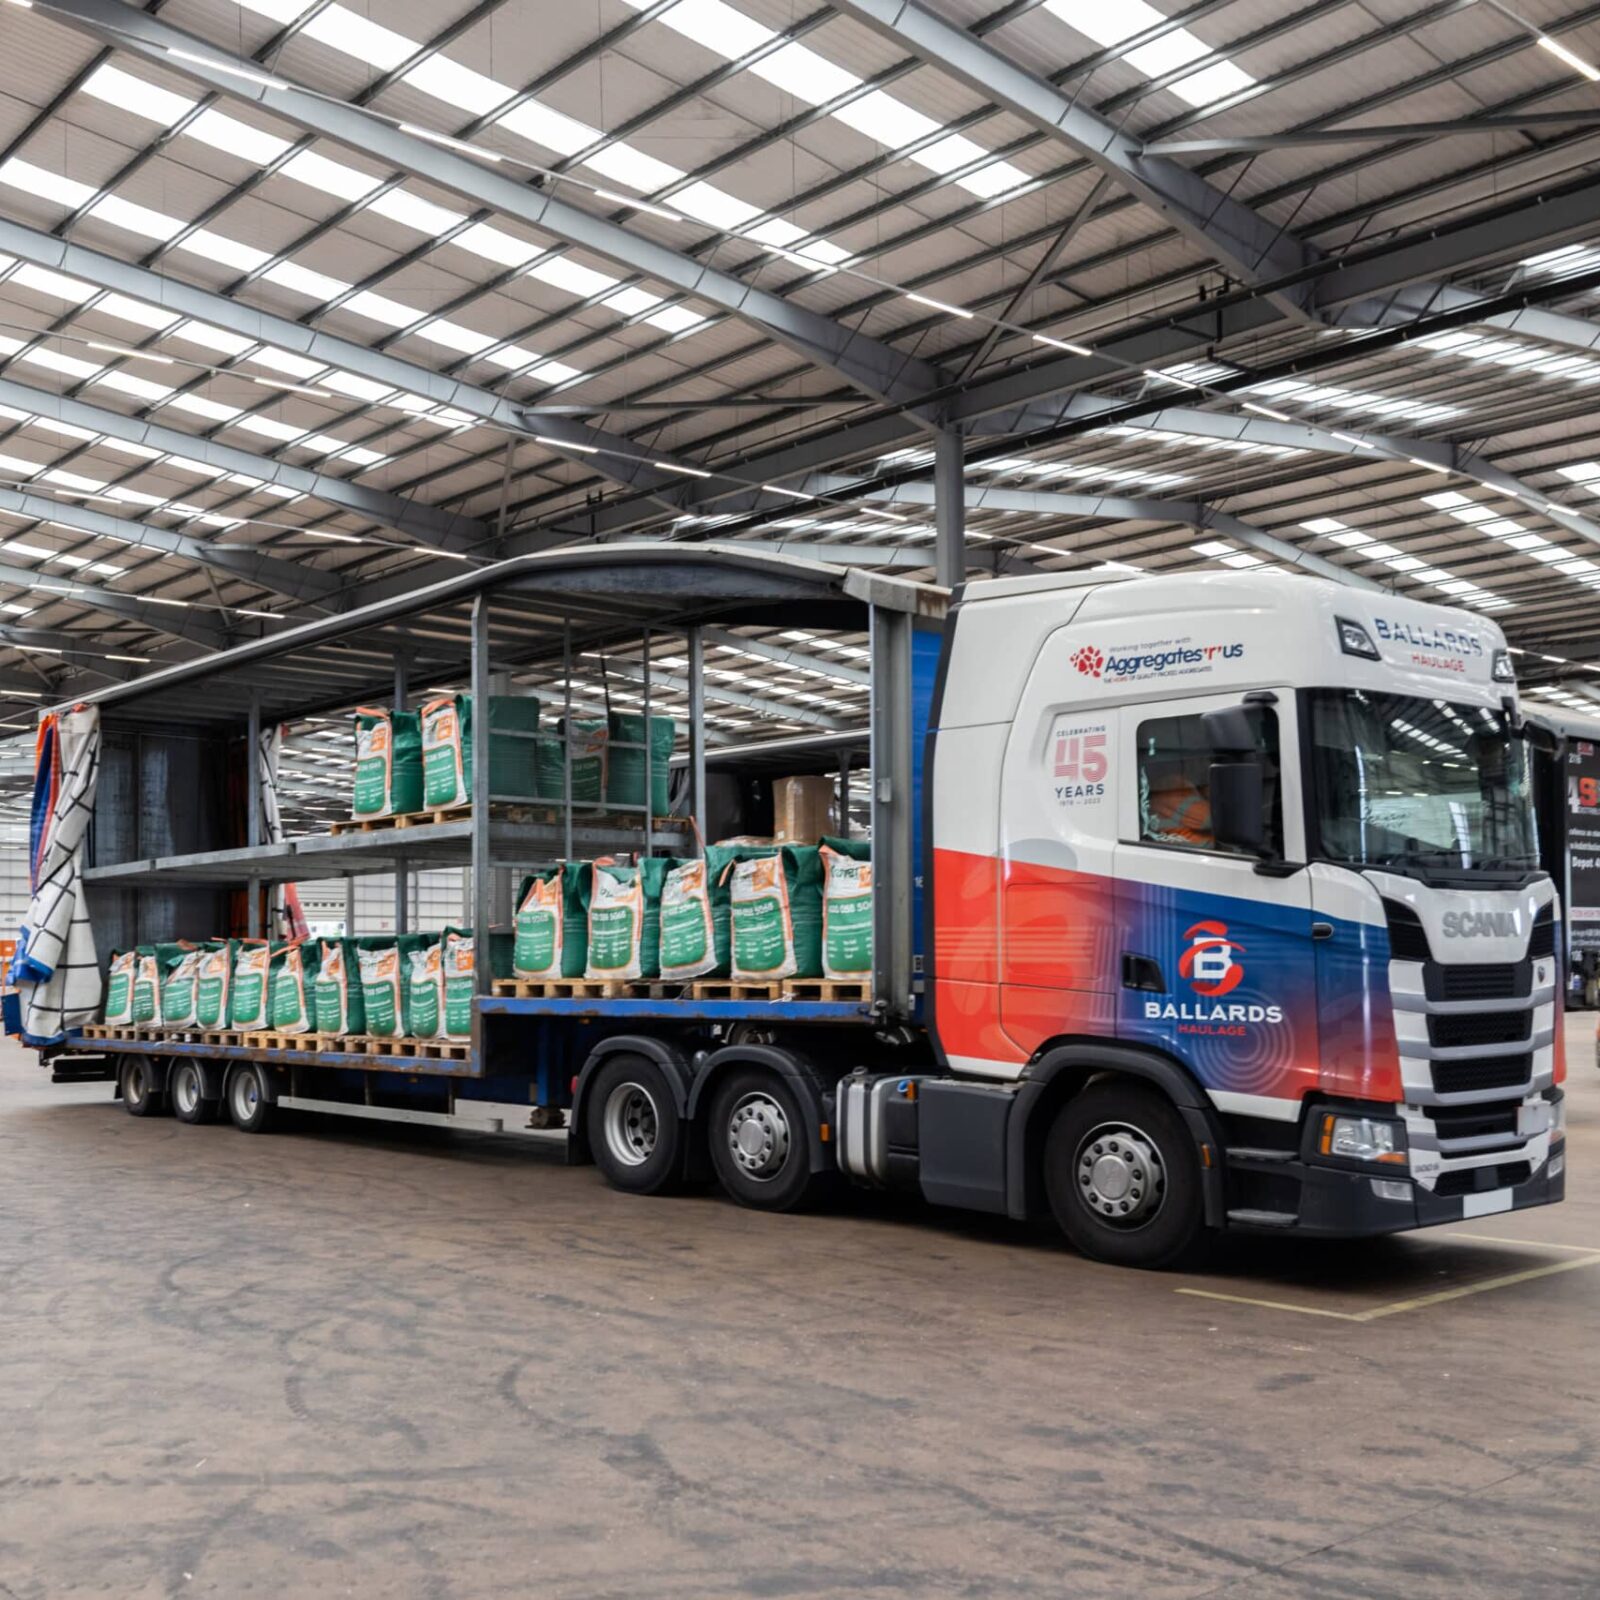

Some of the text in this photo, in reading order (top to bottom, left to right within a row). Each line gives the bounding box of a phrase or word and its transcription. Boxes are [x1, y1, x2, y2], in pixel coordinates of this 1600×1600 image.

[1140, 639, 1173, 650] together
[1174, 637, 1191, 645] with
[1374, 618, 1482, 656] BALLARDS
[1105, 647, 1203, 676] Aggregates
[1411, 653, 1465, 673] HAULAGE
[1056, 725, 1106, 737] CELEBRATING
[1054, 734, 1108, 783] 45
[1055, 783, 1105, 799] YEARS
[1442, 911, 1519, 938] SCANIA
[1145, 1002, 1283, 1023] BALLARDS
[1178, 1024, 1247, 1036] HAULAGE
